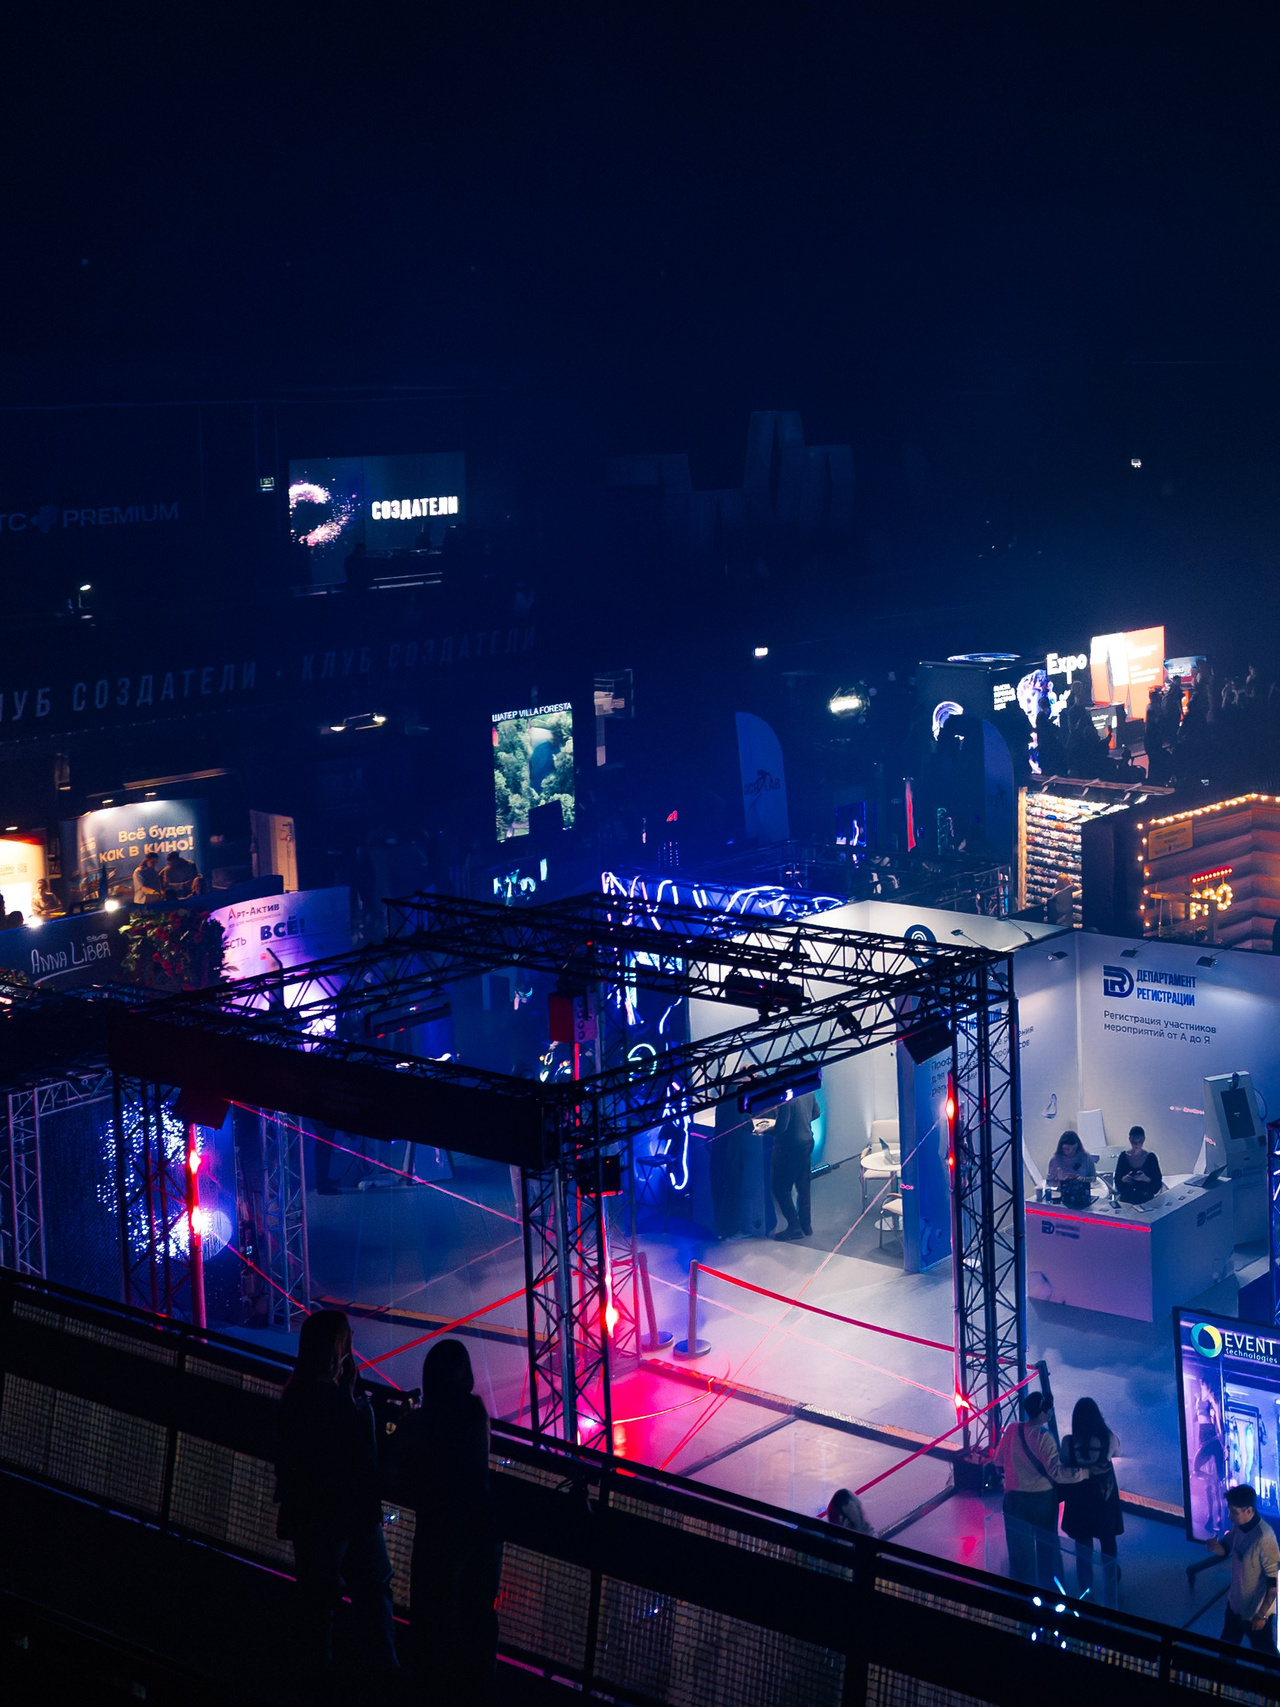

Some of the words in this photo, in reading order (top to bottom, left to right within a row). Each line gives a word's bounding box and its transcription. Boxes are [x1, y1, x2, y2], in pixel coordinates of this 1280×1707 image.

[62, 502, 179, 528] PREMIUM
[371, 496, 459, 520] СОЗДАТЕЛИ
[301, 646, 372, 681] КЛУБ
[389, 626, 537, 668] СОЗДАТЕЛИ
[1046, 653, 1088, 685] Expo
[72, 662, 256, 711] СОЗДАТЕЛИ
[491, 710, 518, 722] ШАТЕР
[519, 707, 540, 718] VILLA
[539, 702, 573, 714] FORESTA
[118, 827, 147, 844] Всё
[148, 824, 195, 839] будет
[98, 847, 126, 864] как
[129, 845, 140, 858] в
[144, 835, 195, 856] кино!
[1136, 968, 1198, 989] ДЕПАРТАМЕНТ
[1136, 987, 1196, 1007] РЕГИСТРАЦИИ
[1103, 1009, 1162, 1027] Регистрация
[1162, 1017, 1218, 1034] участников
[1103, 1021, 1165, 1041] мероприятий
[1166, 1031, 1178, 1041] от
[1179, 1031, 1188, 1042] А
[1189, 1033, 1202, 1044] до
[1203, 1035, 1211, 1045] Я
[1224, 1331, 1277, 1356] EVENT
[1225, 1347, 1278, 1365] technologies
